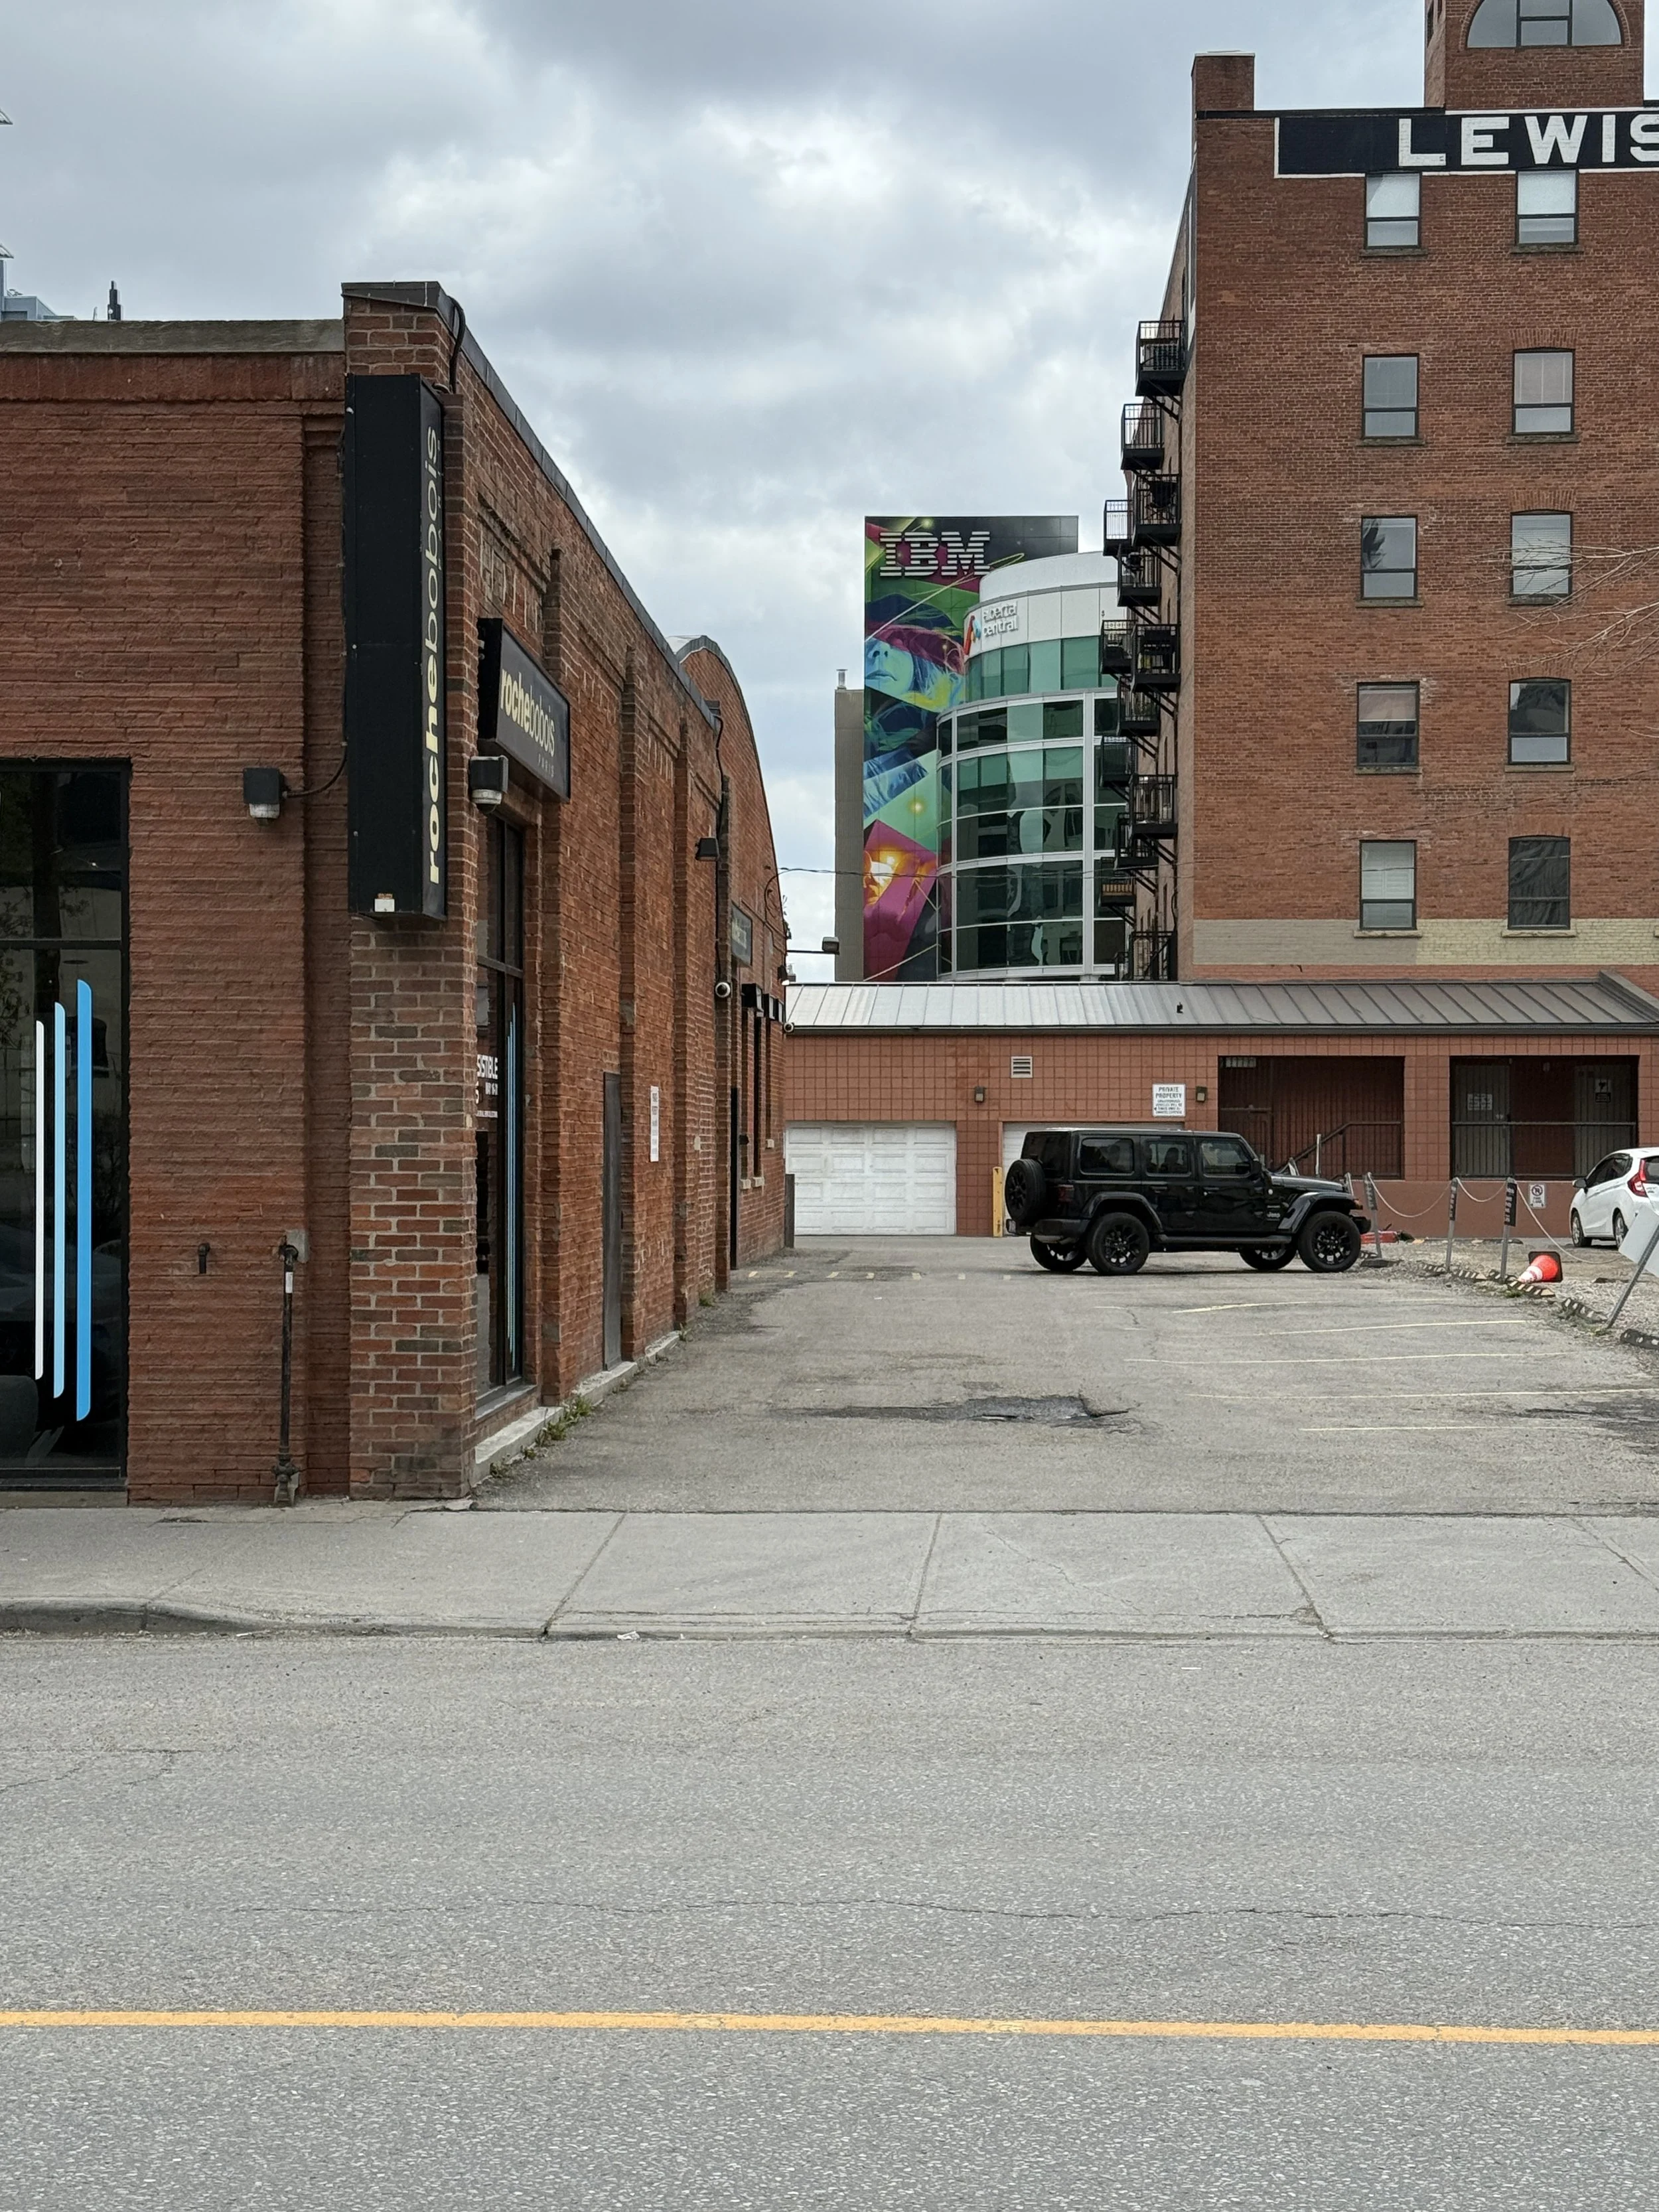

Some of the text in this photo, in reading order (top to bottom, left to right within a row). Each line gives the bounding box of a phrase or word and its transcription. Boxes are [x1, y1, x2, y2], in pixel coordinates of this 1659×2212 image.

[1398, 114, 1659, 167] LEWIS
[880, 531, 990, 577] IBM
[983, 601, 1017, 623] alberta
[983, 616, 1019, 638] central
[425, 426, 439, 885] rochebobois
[500, 668, 555, 757] rochebobois
